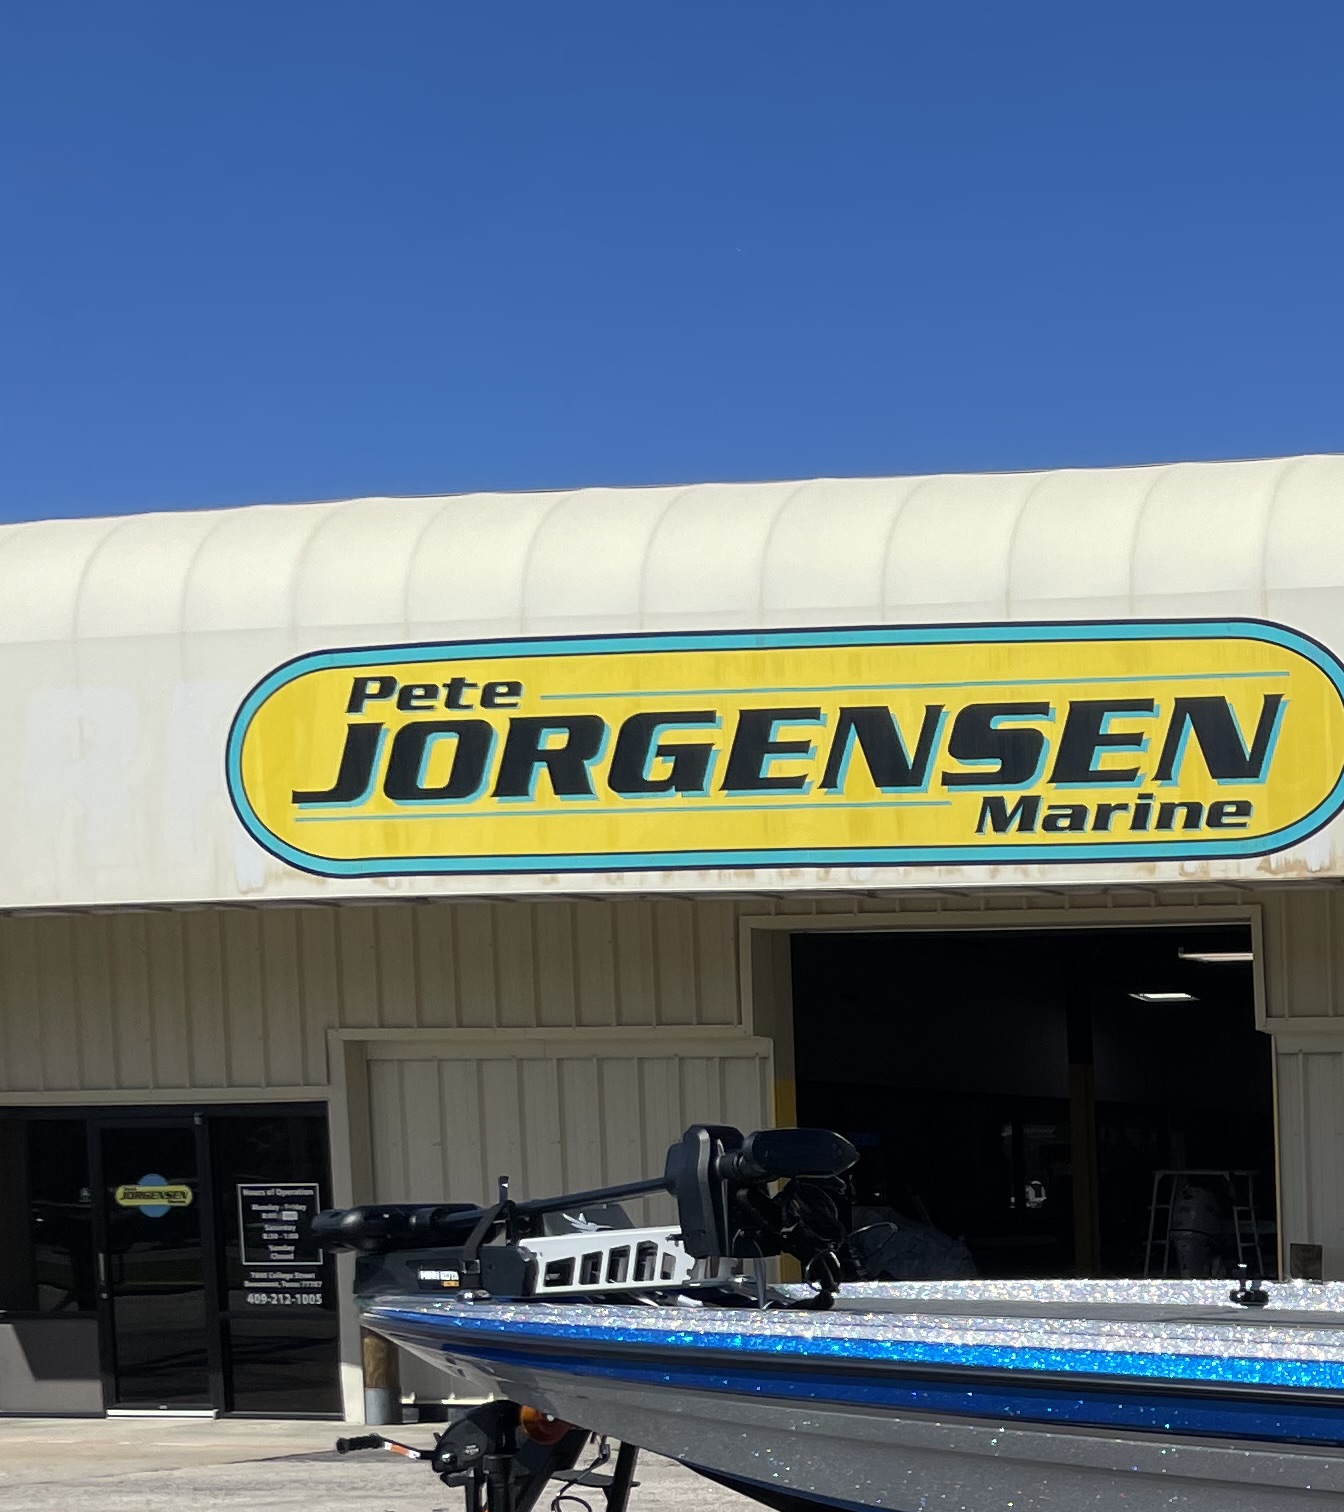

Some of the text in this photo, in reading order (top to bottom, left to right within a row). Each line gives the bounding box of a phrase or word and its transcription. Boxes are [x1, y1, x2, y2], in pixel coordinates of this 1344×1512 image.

[346, 676, 524, 714] Pete
[291, 694, 1289, 807] JORGENSEN
[974, 793, 1254, 835] Marine
[246, 1293, 323, 1305] 409-212-1005
